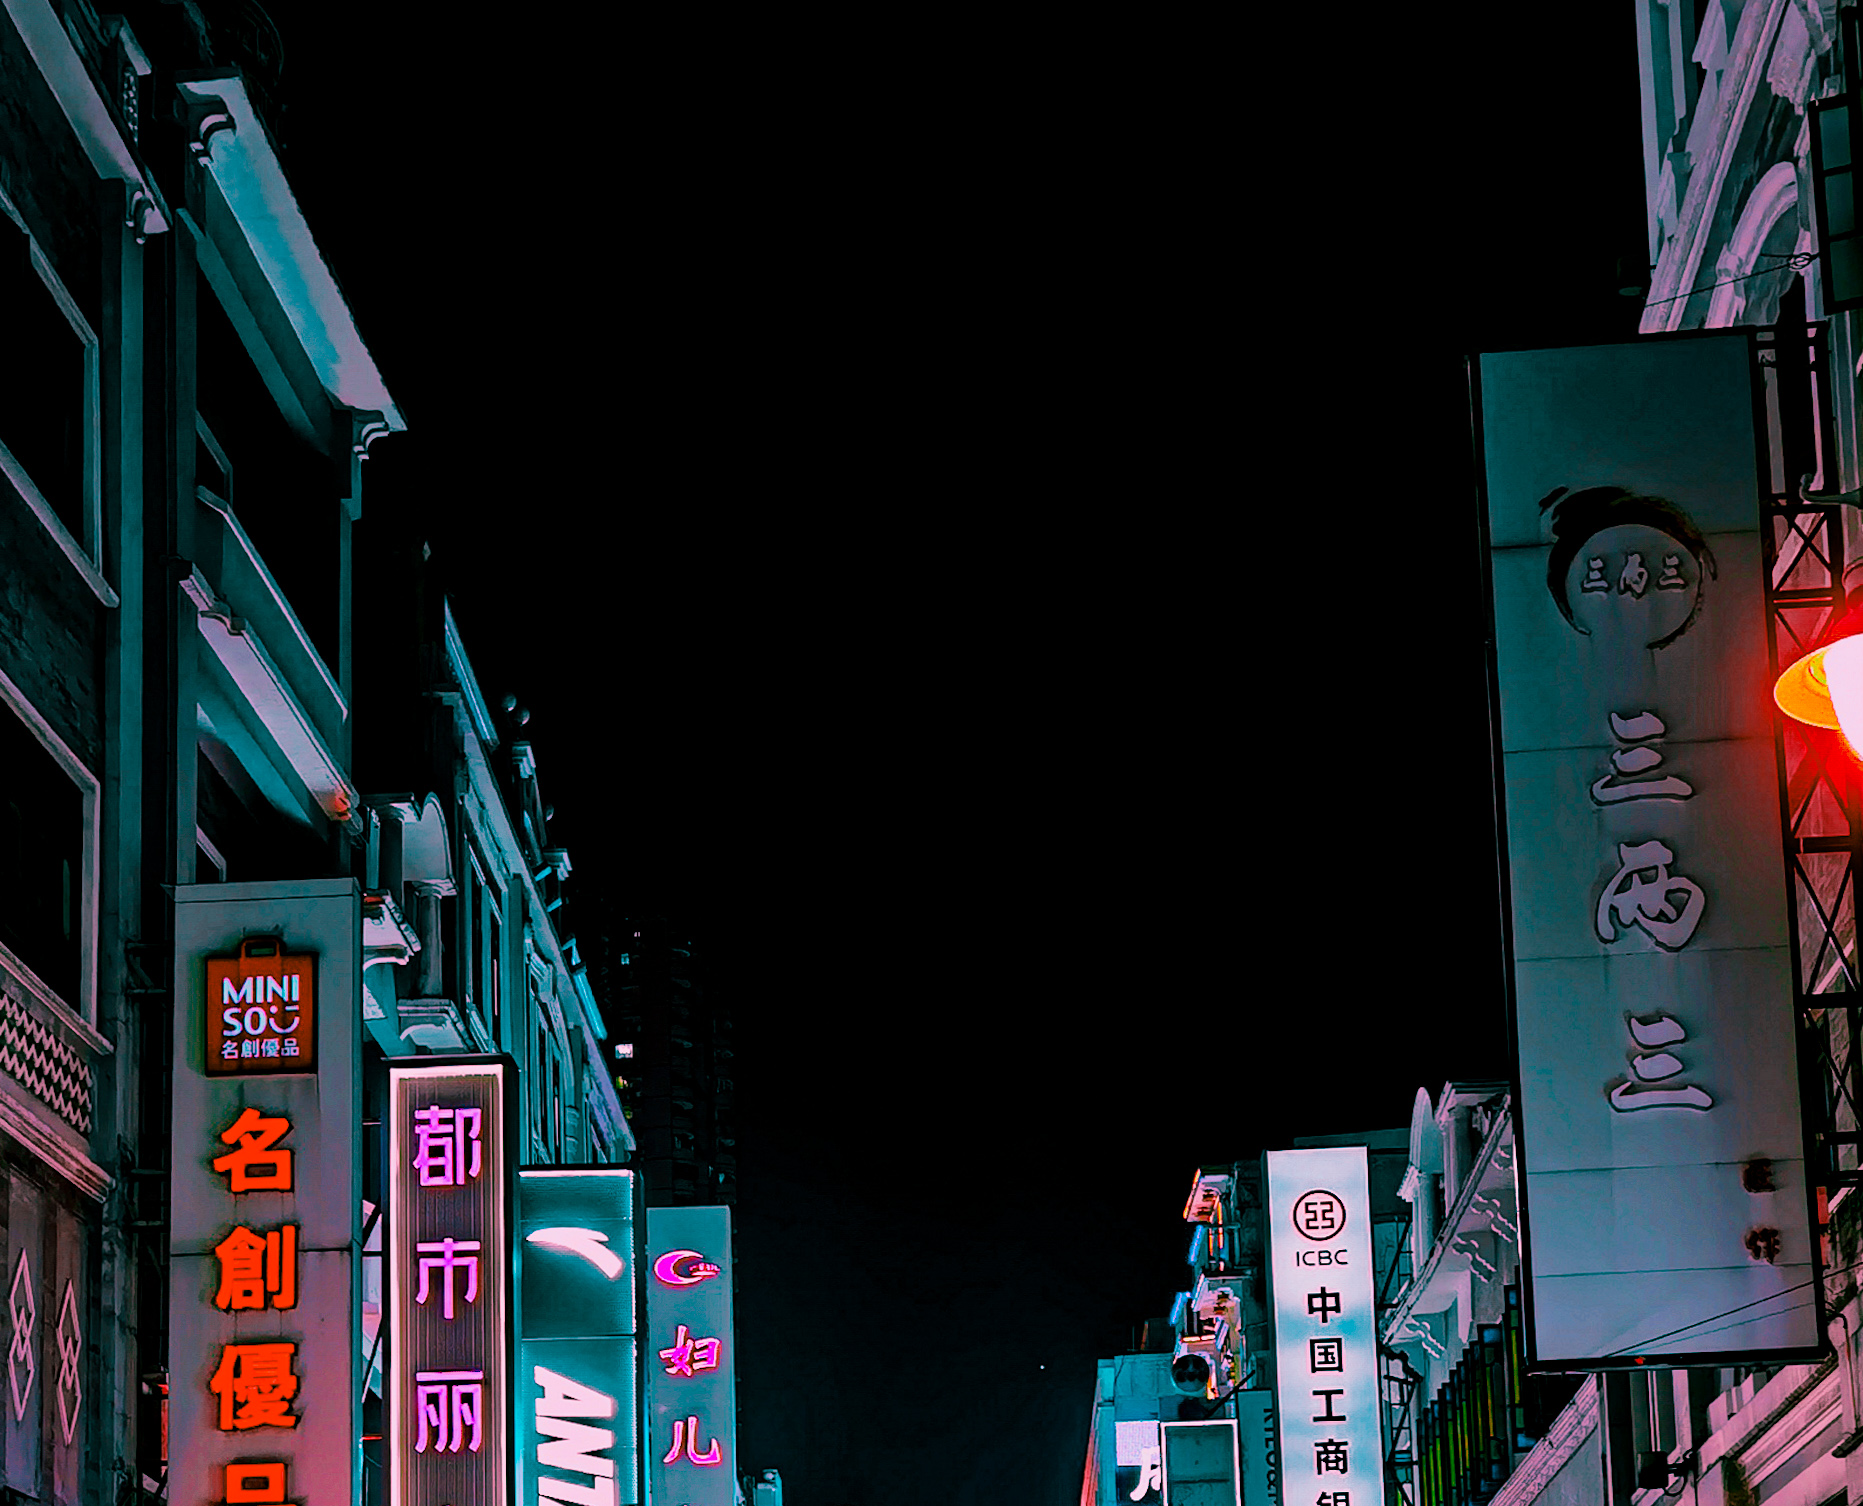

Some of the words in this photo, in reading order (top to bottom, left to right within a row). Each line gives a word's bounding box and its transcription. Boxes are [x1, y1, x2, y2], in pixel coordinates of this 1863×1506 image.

[222, 974, 300, 1004] MINI
[221, 1037, 300, 1059] 名創優品
[1296, 1249, 1348, 1267] ICBC
